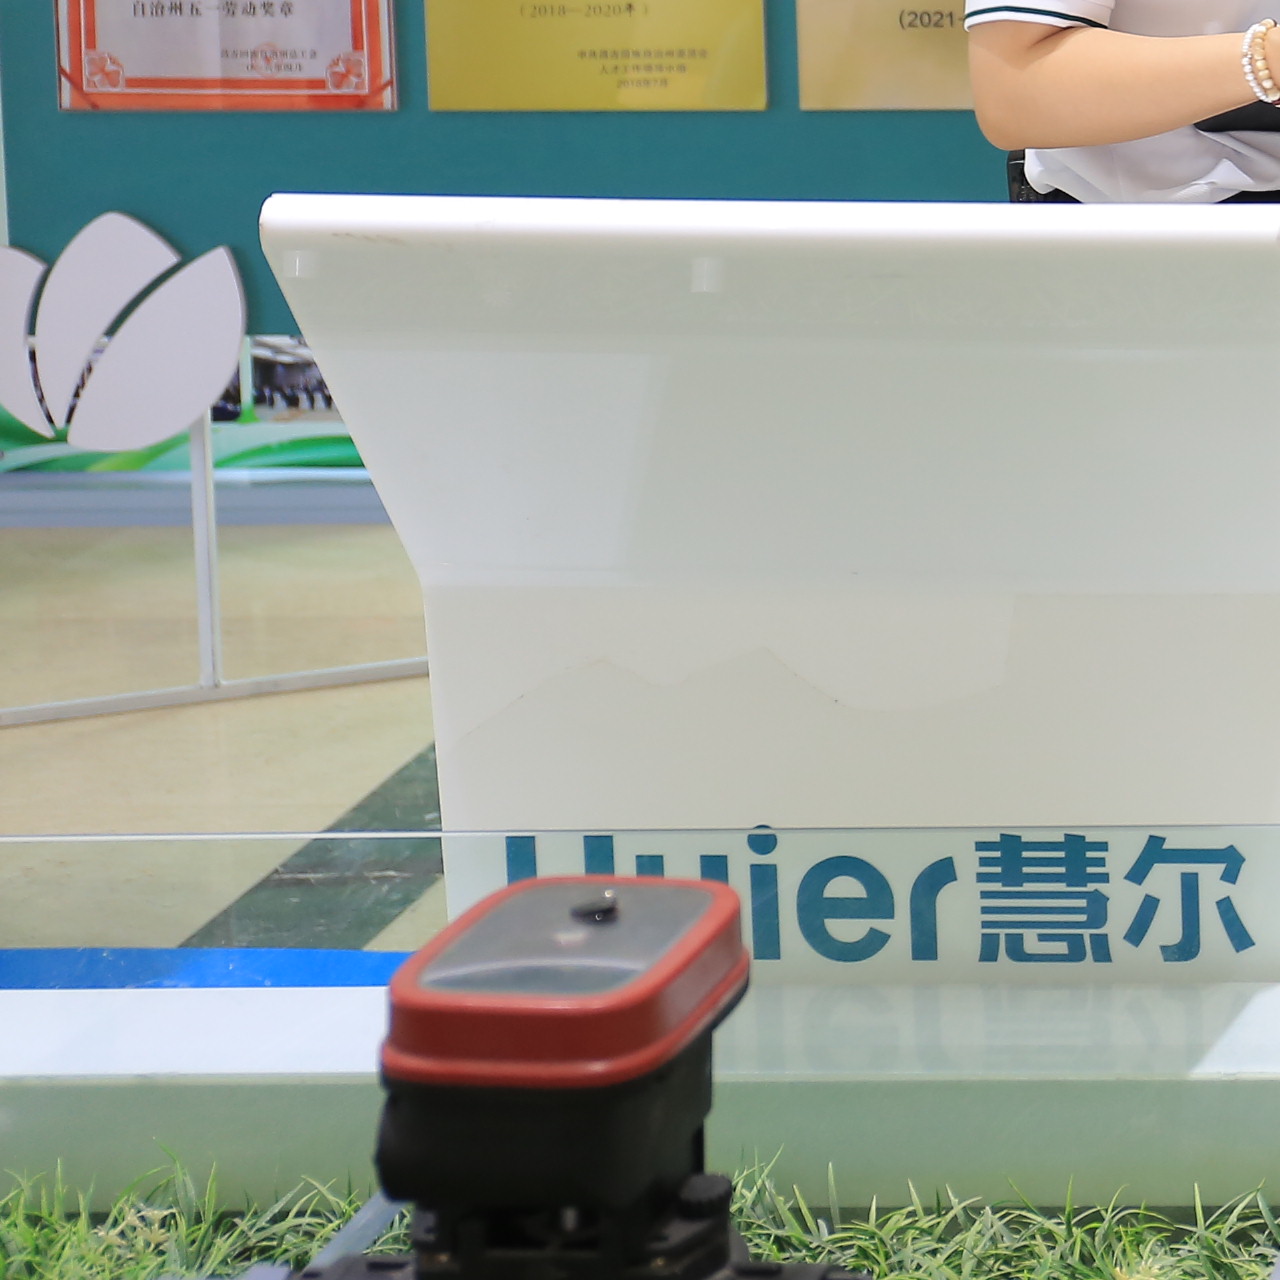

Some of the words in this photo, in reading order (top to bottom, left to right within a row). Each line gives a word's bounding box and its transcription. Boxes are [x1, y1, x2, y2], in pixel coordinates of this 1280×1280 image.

[132, 0, 294, 18] 自治州五一劳动奖章
[505, 824, 1256, 963] ier慧尔
